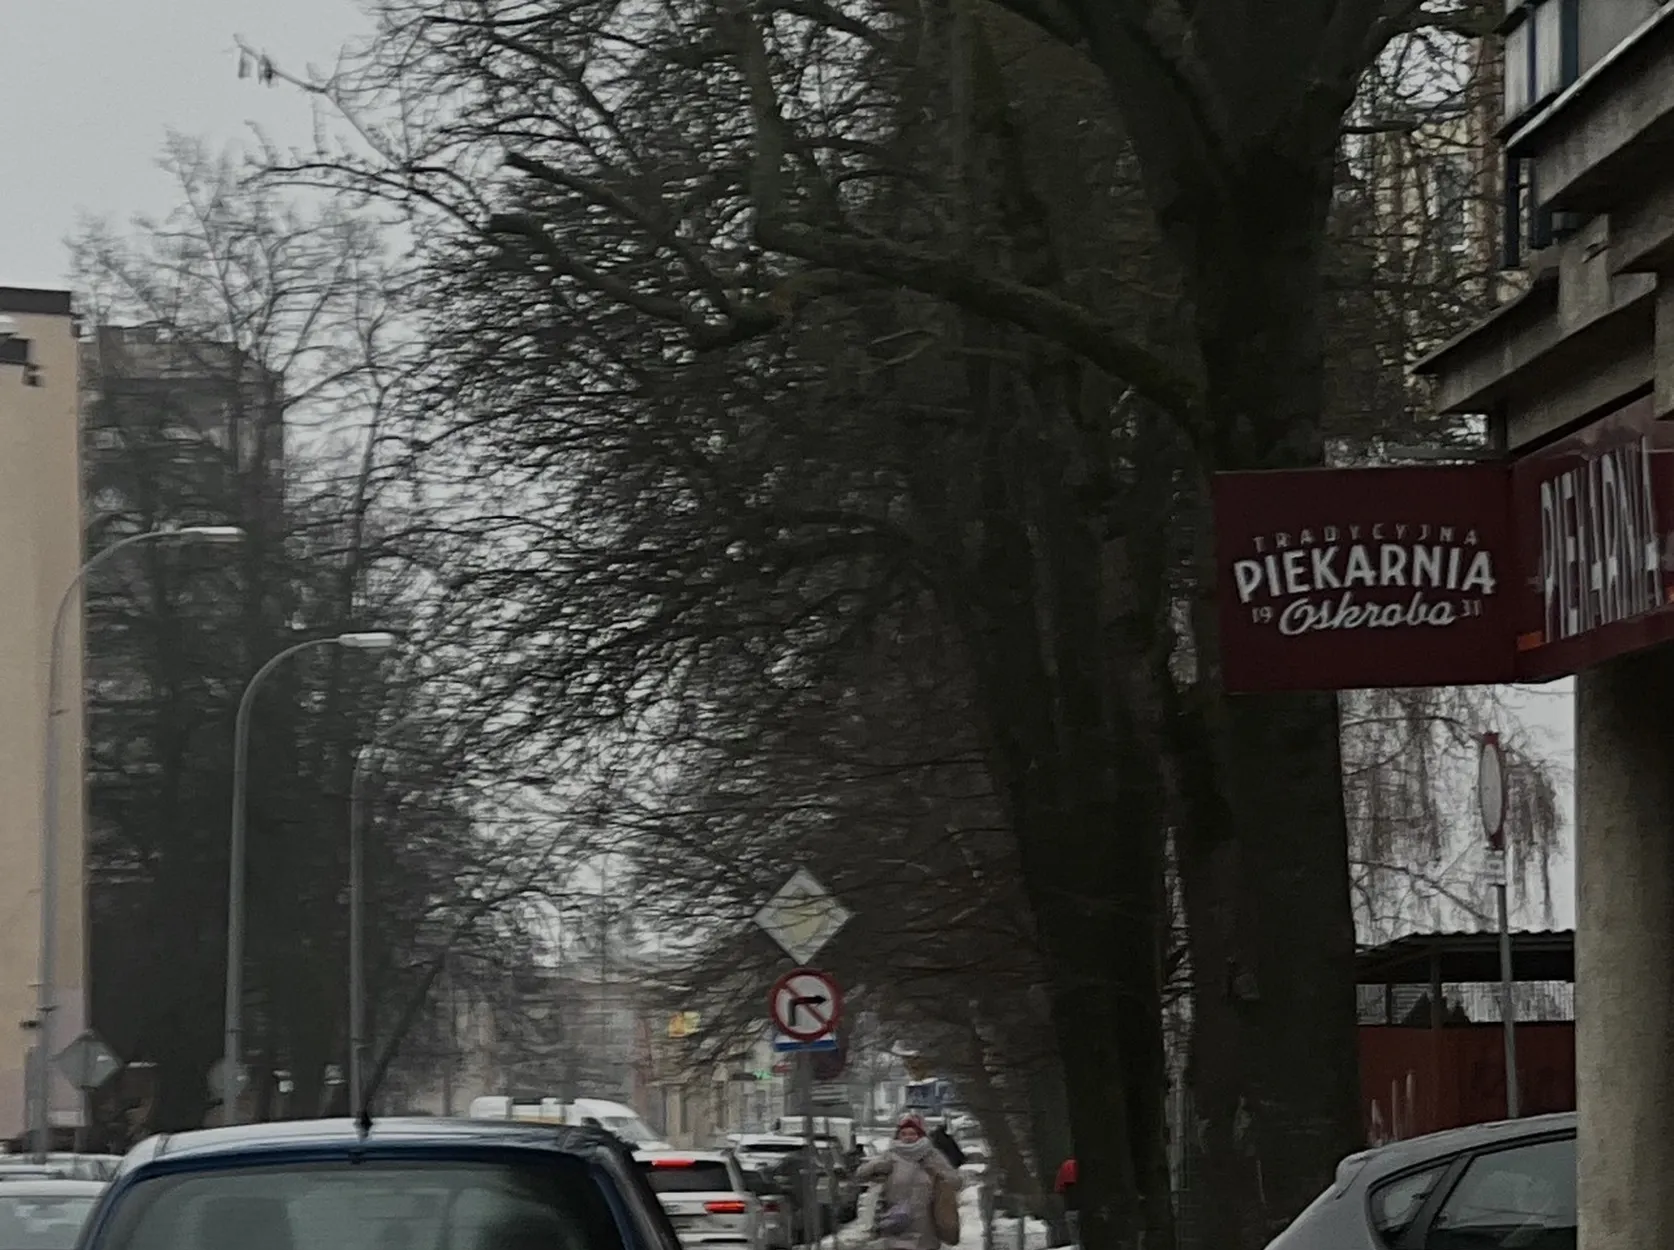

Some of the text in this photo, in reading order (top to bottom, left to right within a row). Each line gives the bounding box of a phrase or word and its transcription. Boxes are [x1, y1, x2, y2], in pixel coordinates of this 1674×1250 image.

[1253, 523, 1479, 552] TRADYCYJNA
[1233, 543, 1496, 604] PIEKARNIA
[1252, 605, 1274, 624] 19
[1278, 590, 1456, 636] Oskroba
